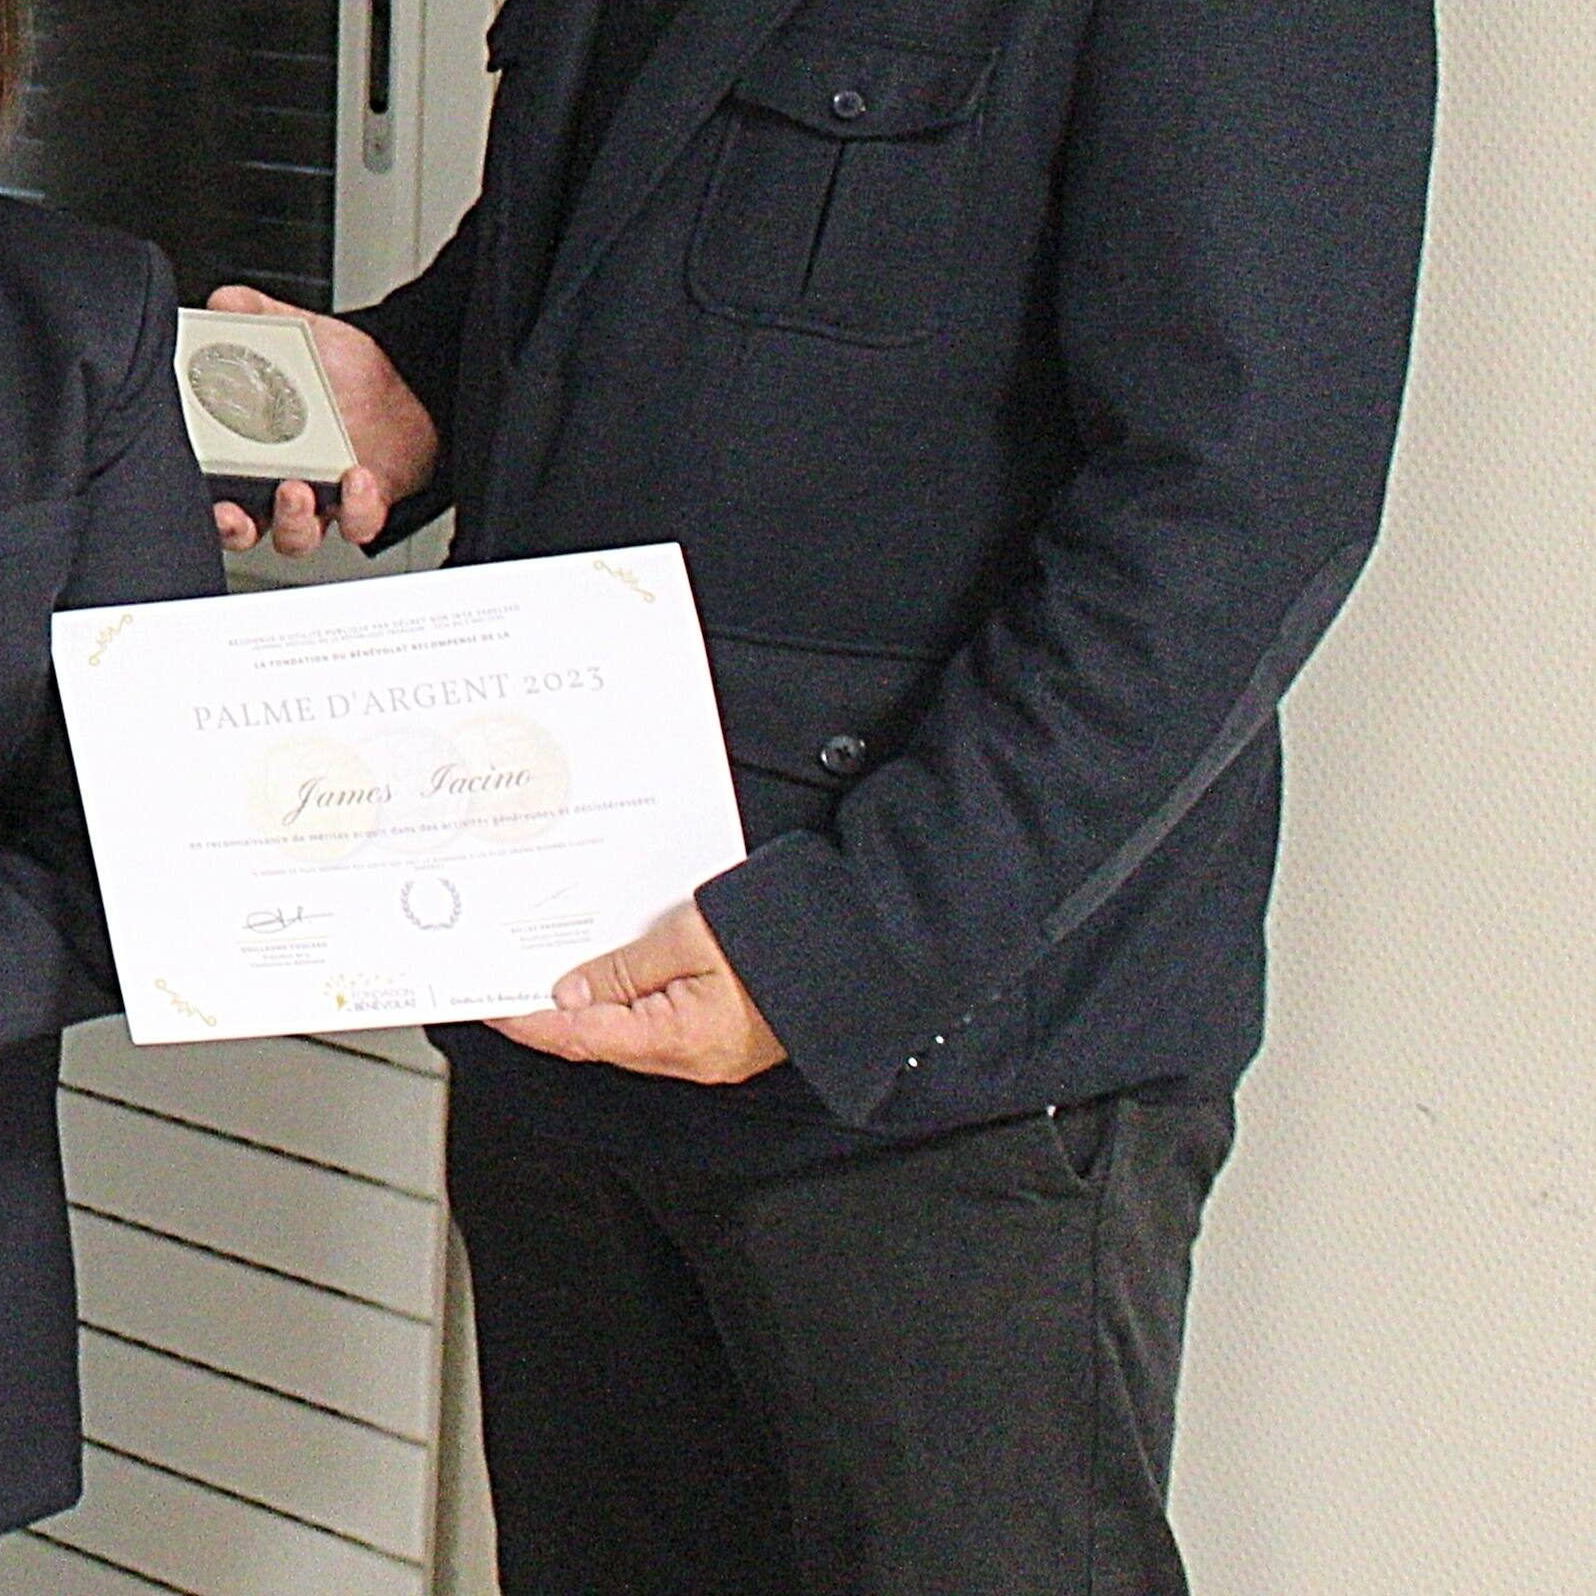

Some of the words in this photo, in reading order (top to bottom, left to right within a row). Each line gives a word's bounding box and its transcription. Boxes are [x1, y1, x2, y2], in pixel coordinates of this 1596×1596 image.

[193, 696, 316, 731] PALME
[326, 672, 510, 720] D'ARGENT
[523, 666, 605, 694] 2023
[282, 775, 393, 827] James
